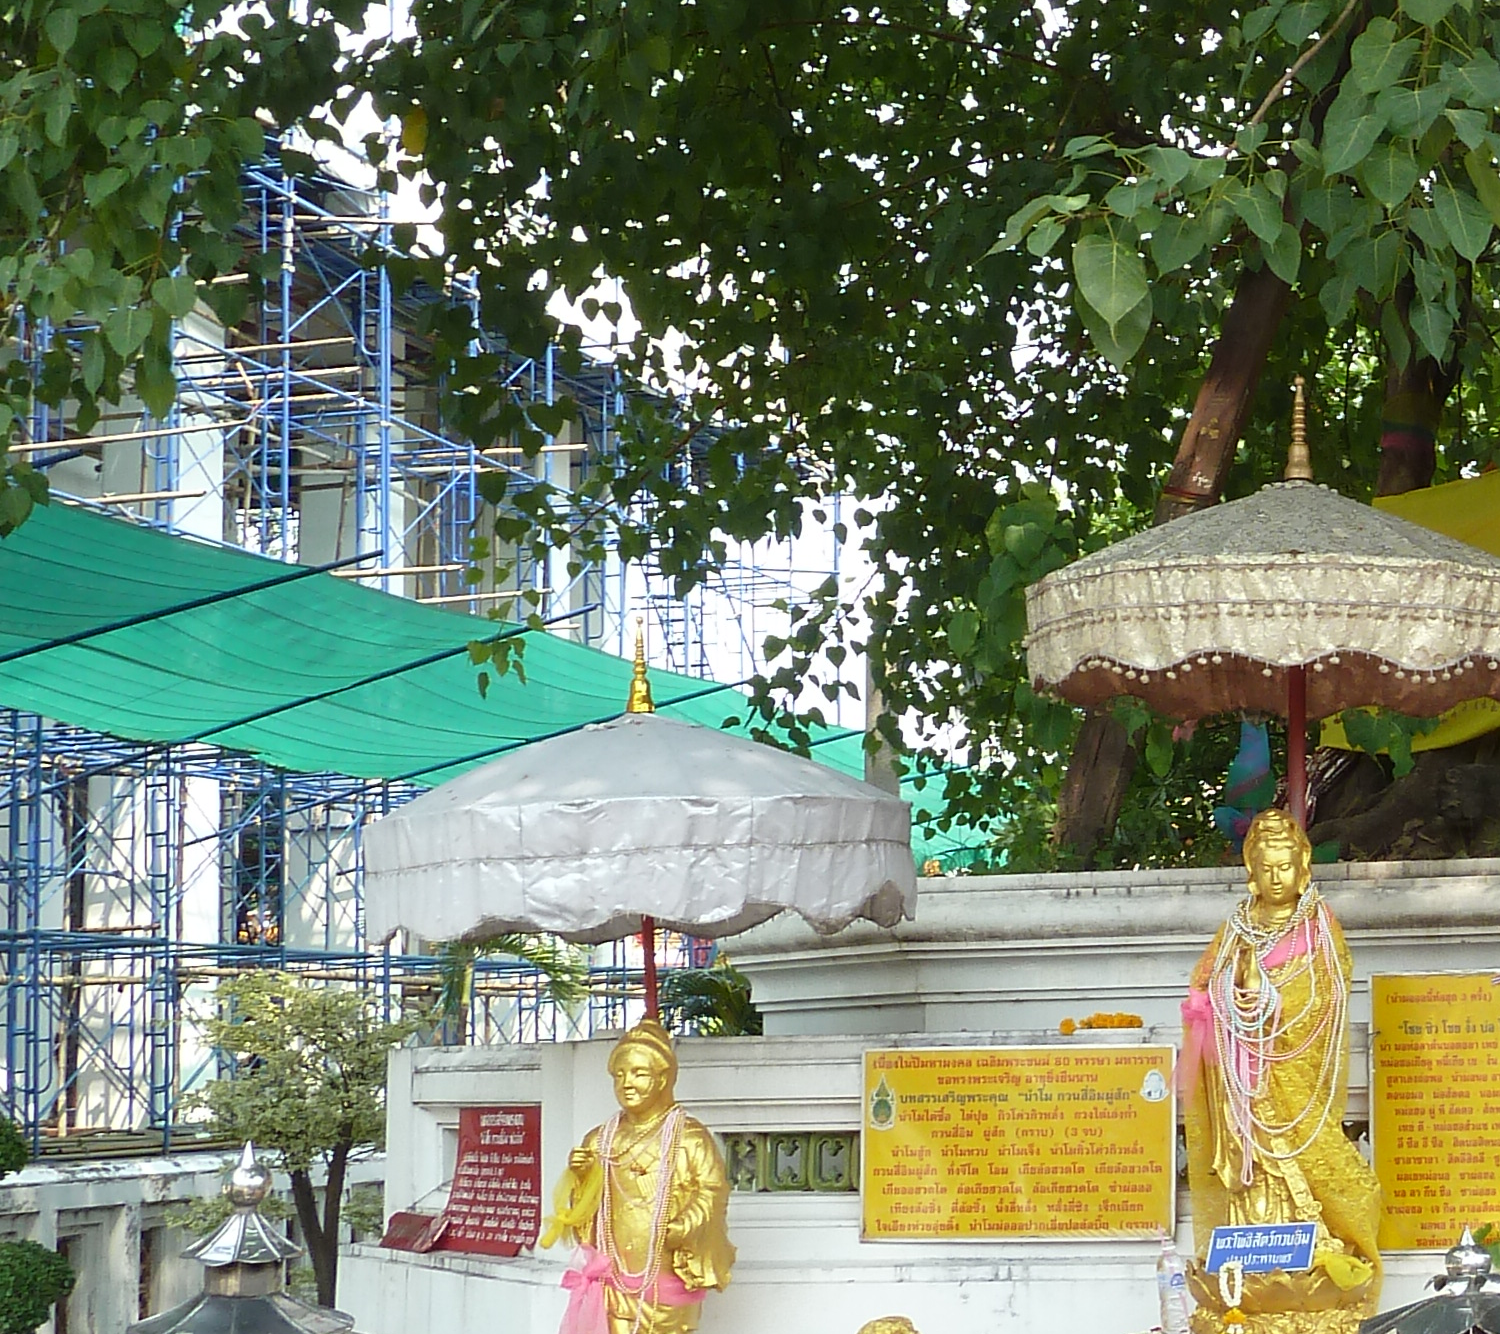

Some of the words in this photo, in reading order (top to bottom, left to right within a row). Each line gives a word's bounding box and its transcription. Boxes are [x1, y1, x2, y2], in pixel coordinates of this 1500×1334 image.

[1054, 1056, 1070, 1065] 80
[1074, 1055, 1110, 1065] พรรษา
[1115, 1054, 1164, 1064] มหาราชา
[938, 1072, 1020, 1087] ขอทรงพระเจริญ
[1016, 1127, 1054, 1138] (กราบ)
[1065, 1127, 1078, 1137] (3
[1082, 1127, 1103, 1137] จบ)
